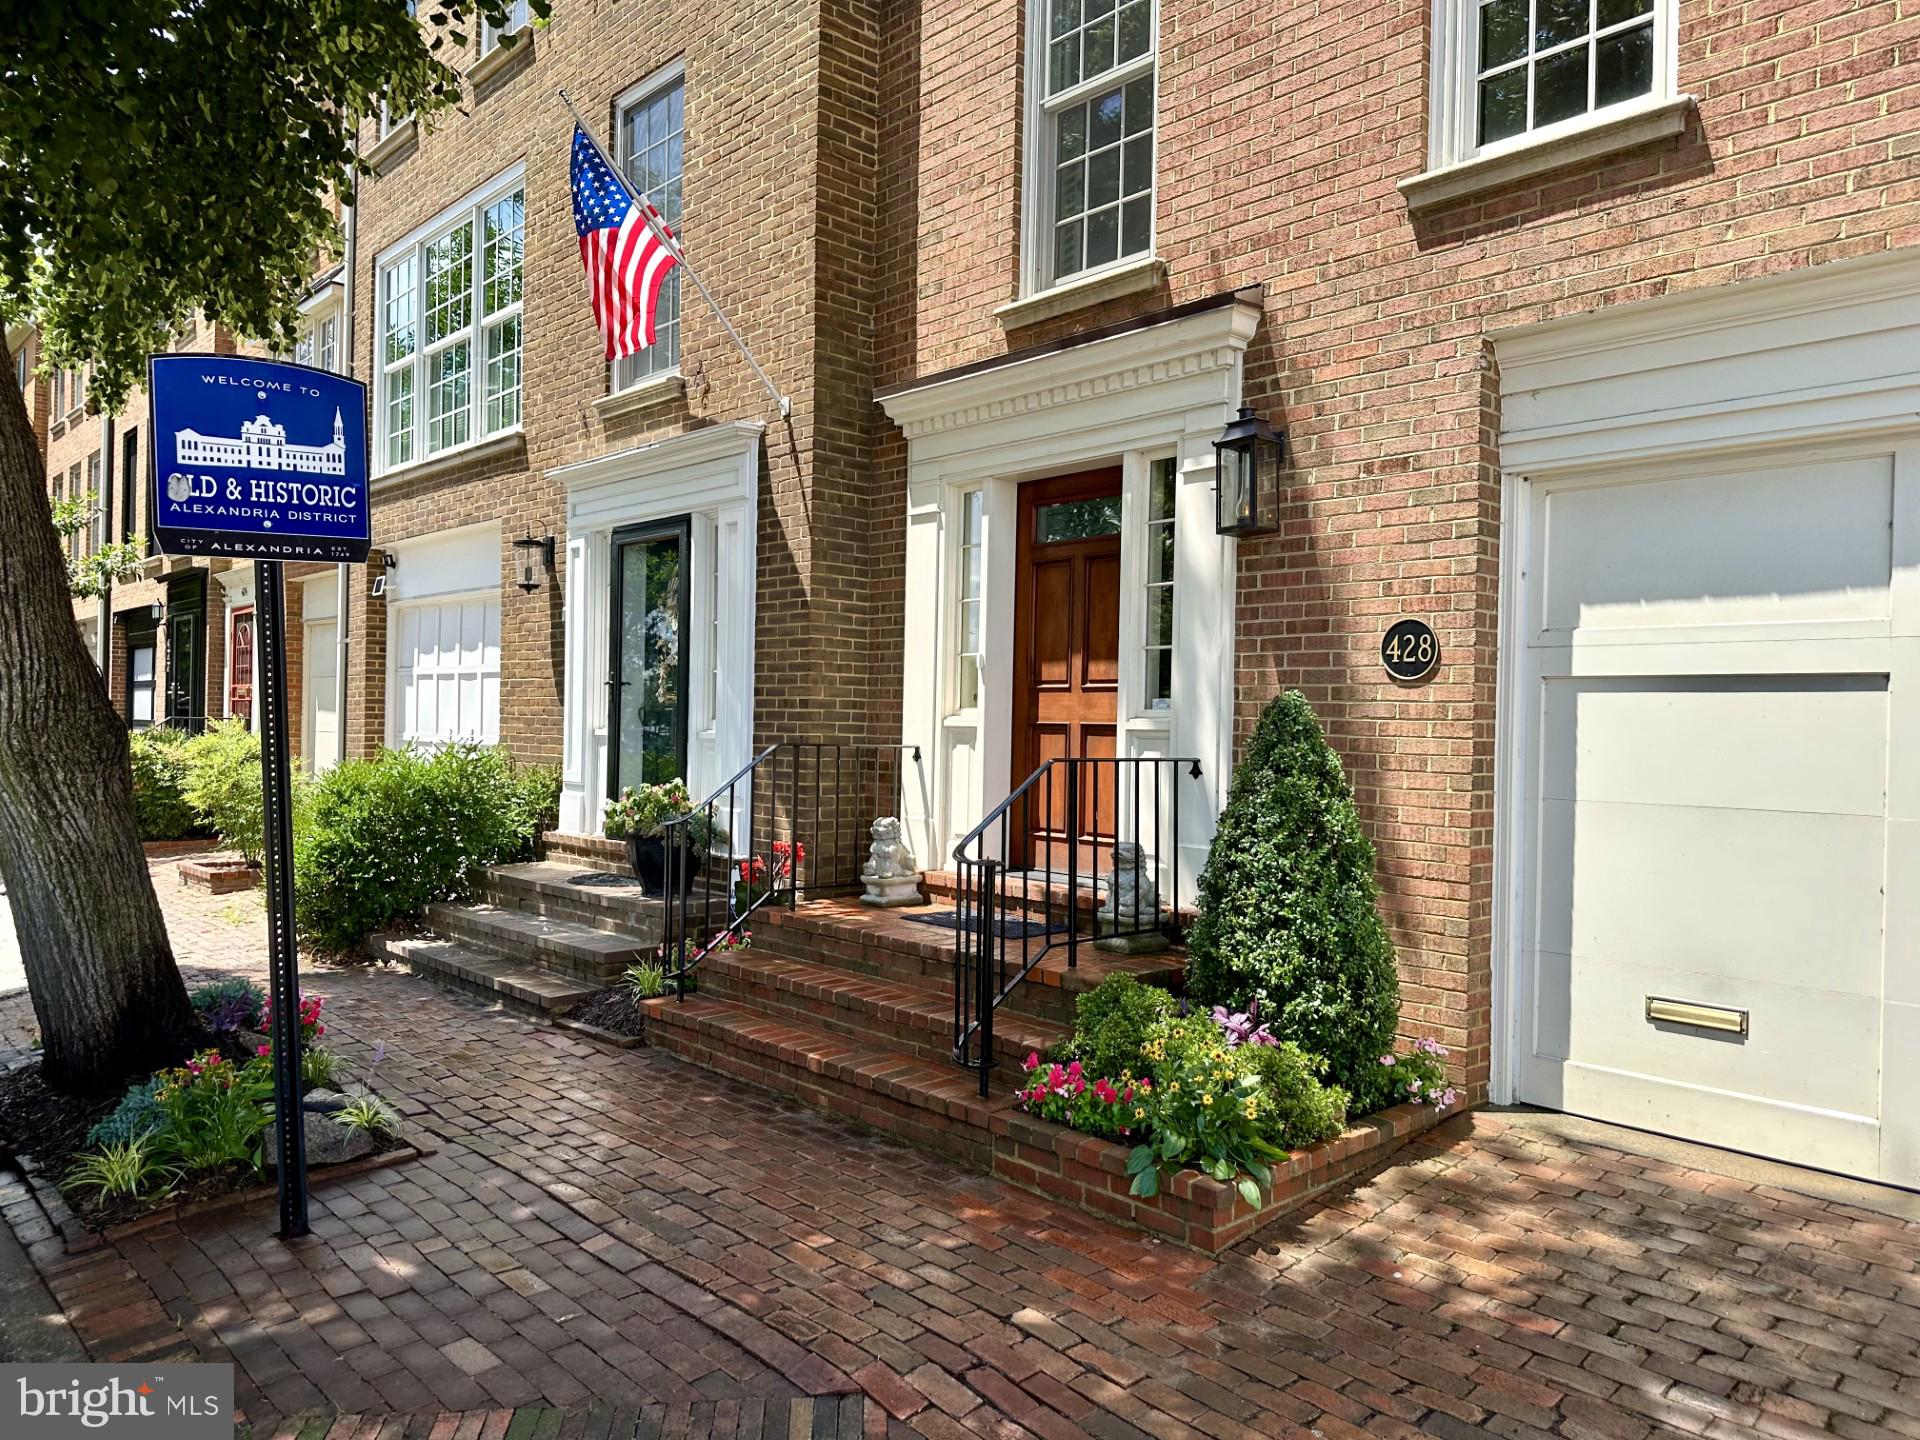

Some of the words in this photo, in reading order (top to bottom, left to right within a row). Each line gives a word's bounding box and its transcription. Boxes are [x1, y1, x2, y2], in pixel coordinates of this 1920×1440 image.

[201, 375, 292, 392] WELCOME
[300, 386, 320, 397] TO
[167, 472, 218, 498] LD
[226, 478, 242, 500] &
[250, 479, 357, 508] HISTORIC
[170, 503, 280, 519] ALEXANDRIA
[288, 511, 357, 523] DISTRICT
[211, 542, 323, 555] ALEXANDRIA
[1385, 633, 1432, 662] 428
